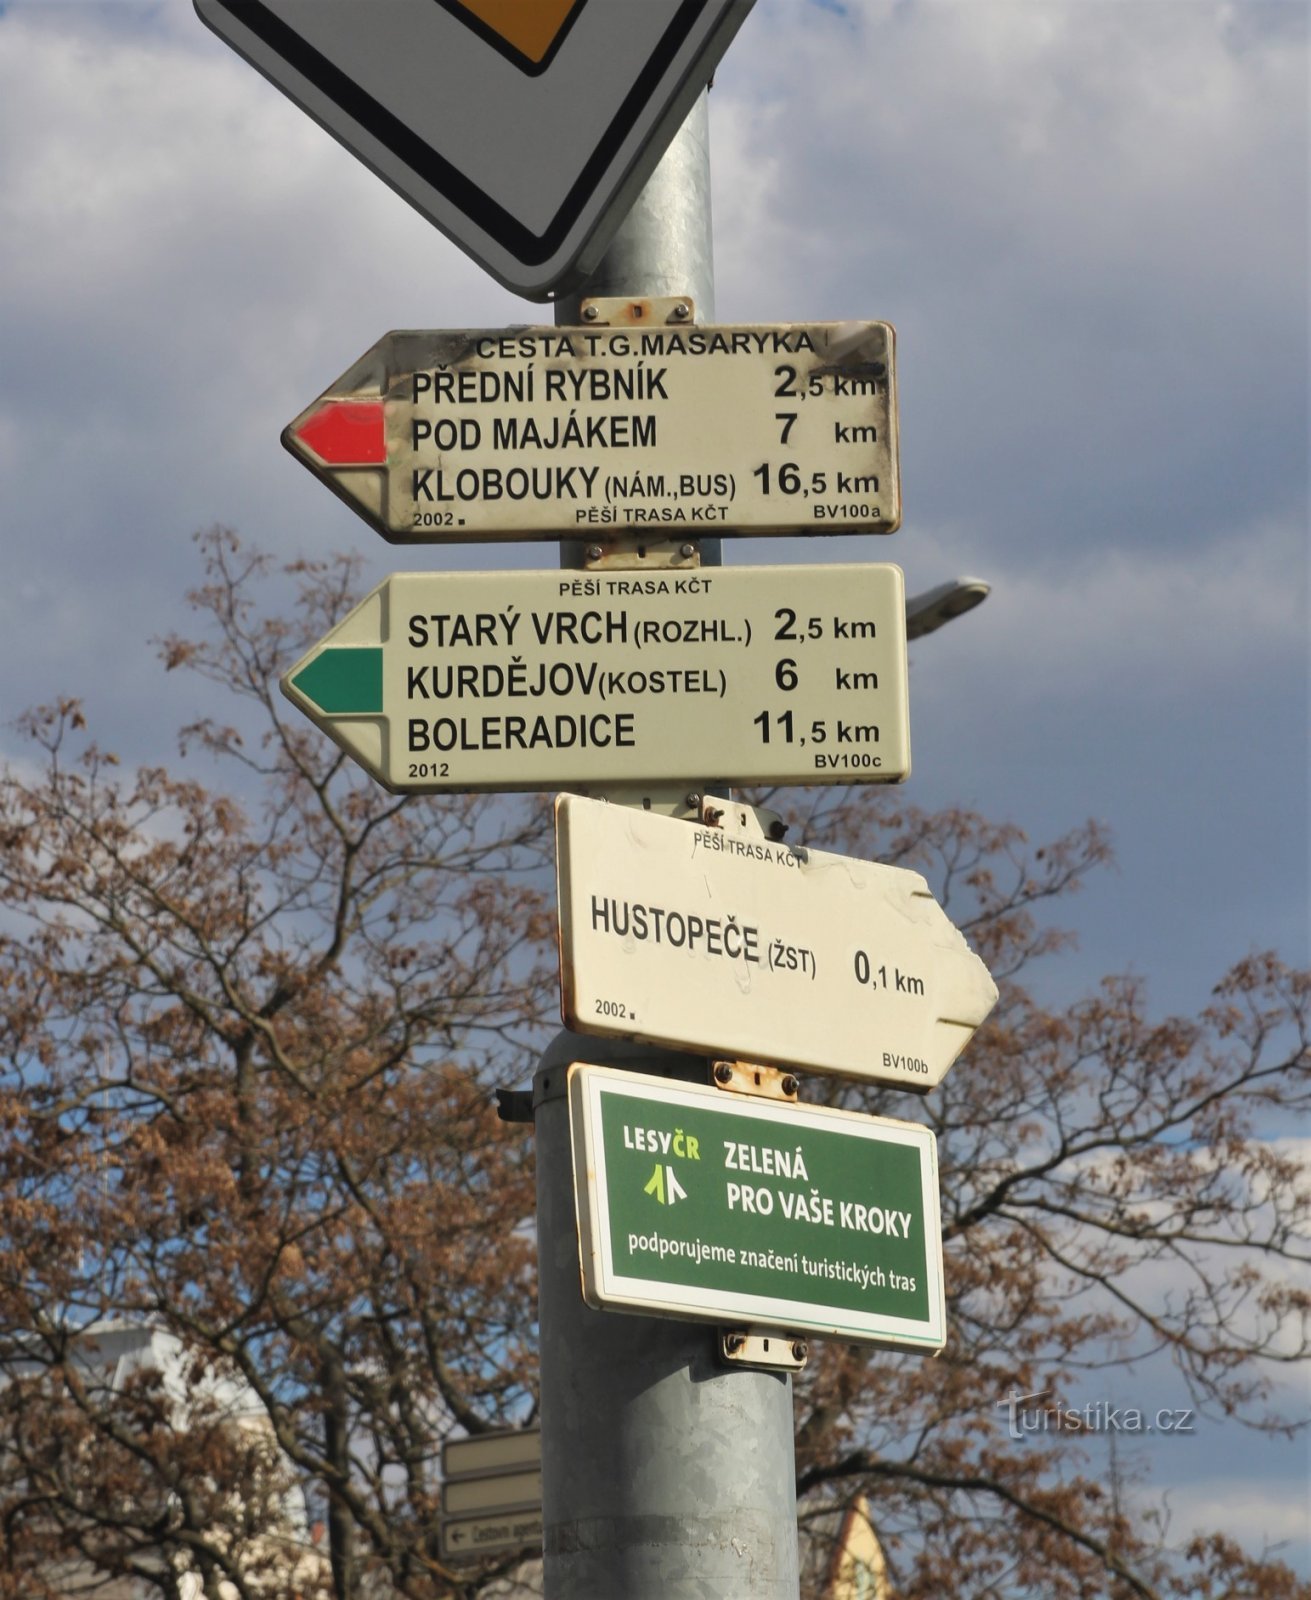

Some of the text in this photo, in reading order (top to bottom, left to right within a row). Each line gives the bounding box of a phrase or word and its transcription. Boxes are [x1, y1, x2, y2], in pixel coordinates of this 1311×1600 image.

[476, 336, 574, 359] CESTA
[413, 362, 876, 404] PŘEDNÍ RYBNÍK 2,5 km
[413, 409, 877, 452] POD MAJÁKEM 7 km
[413, 466, 600, 502] KLOBOUKY
[753, 464, 827, 496] 16,5
[837, 473, 879, 493] km
[575, 505, 729, 523] PĚŠÍ TRASA KČT
[813, 505, 880, 520] BV100a
[559, 578, 712, 596] PĚŠÍ TRASA KČT
[409, 605, 876, 648] STARÝ VRCH (ROZHL.) 2,5 km
[775, 658, 798, 691] 6
[836, 668, 878, 689] km
[409, 711, 879, 751] BOLERADICE 11,5 km
[409, 763, 449, 778] 2012
[814, 754, 881, 768] BV100c
[694, 832, 803, 868] PĚŠÍ TRASA KČT
[591, 895, 924, 995] HUSTOPEČE (ŽST) 0,1 km
[883, 1053, 928, 1074] BV100b
[724, 1142, 808, 1181] ZELENÁ
[727, 1183, 912, 1239] PRO VAŠE KROKY
[629, 1233, 916, 1292] podporujeme značení turistických tras
